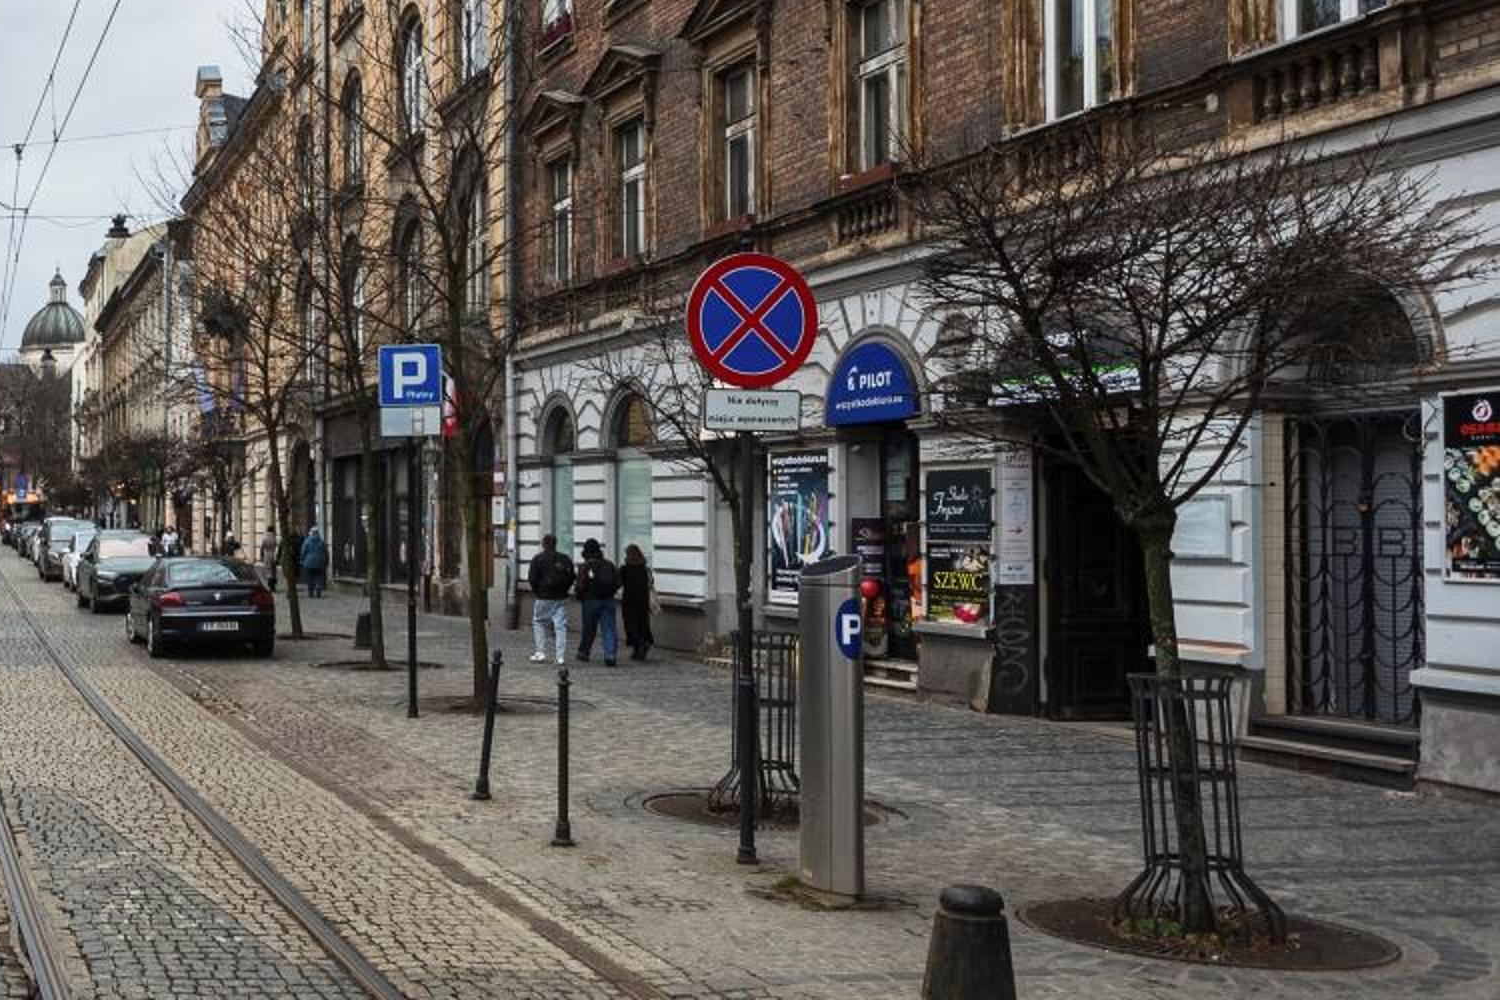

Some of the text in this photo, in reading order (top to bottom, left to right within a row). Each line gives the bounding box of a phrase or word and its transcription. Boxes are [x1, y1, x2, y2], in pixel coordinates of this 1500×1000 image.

[393, 353, 427, 399] P
[859, 371, 892, 390] PILOT
[933, 571, 983, 591] SZEWC
[841, 613, 861, 646] P
